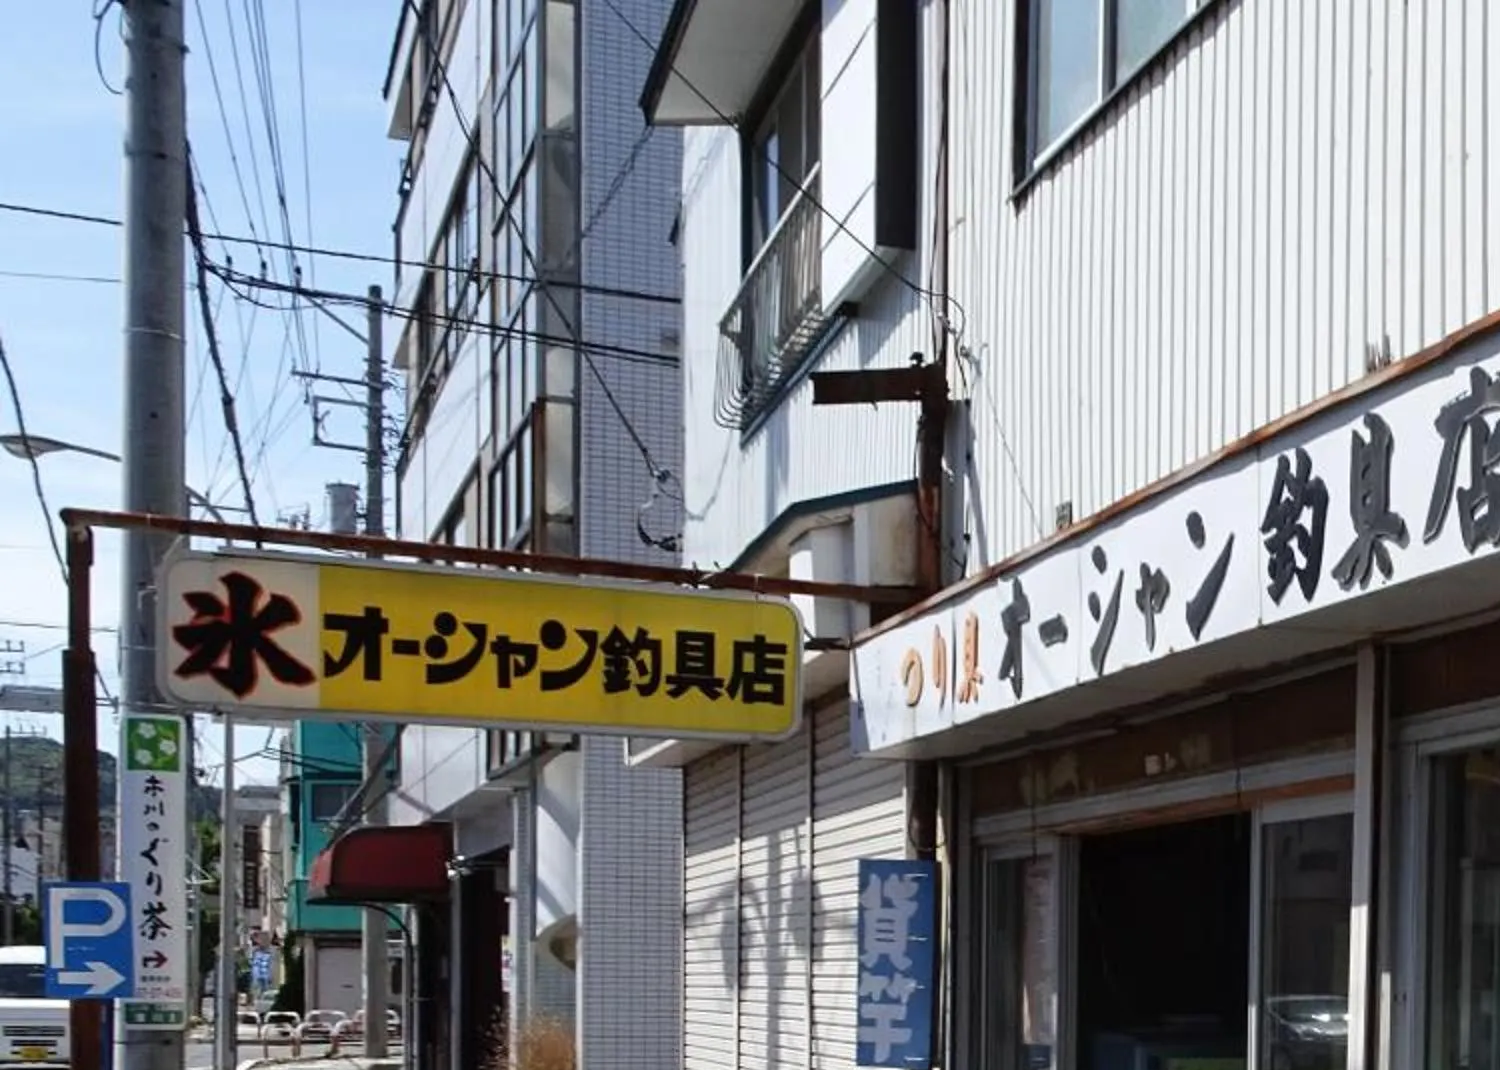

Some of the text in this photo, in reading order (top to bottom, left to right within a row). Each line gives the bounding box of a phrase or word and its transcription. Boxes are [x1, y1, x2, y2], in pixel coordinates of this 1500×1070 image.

[171, 571, 791, 707] 氷 オーシャン釣具店
[901, 608, 984, 713] つり具
[48, 887, 127, 969] P
[858, 872, 921, 1065] 貸竿
